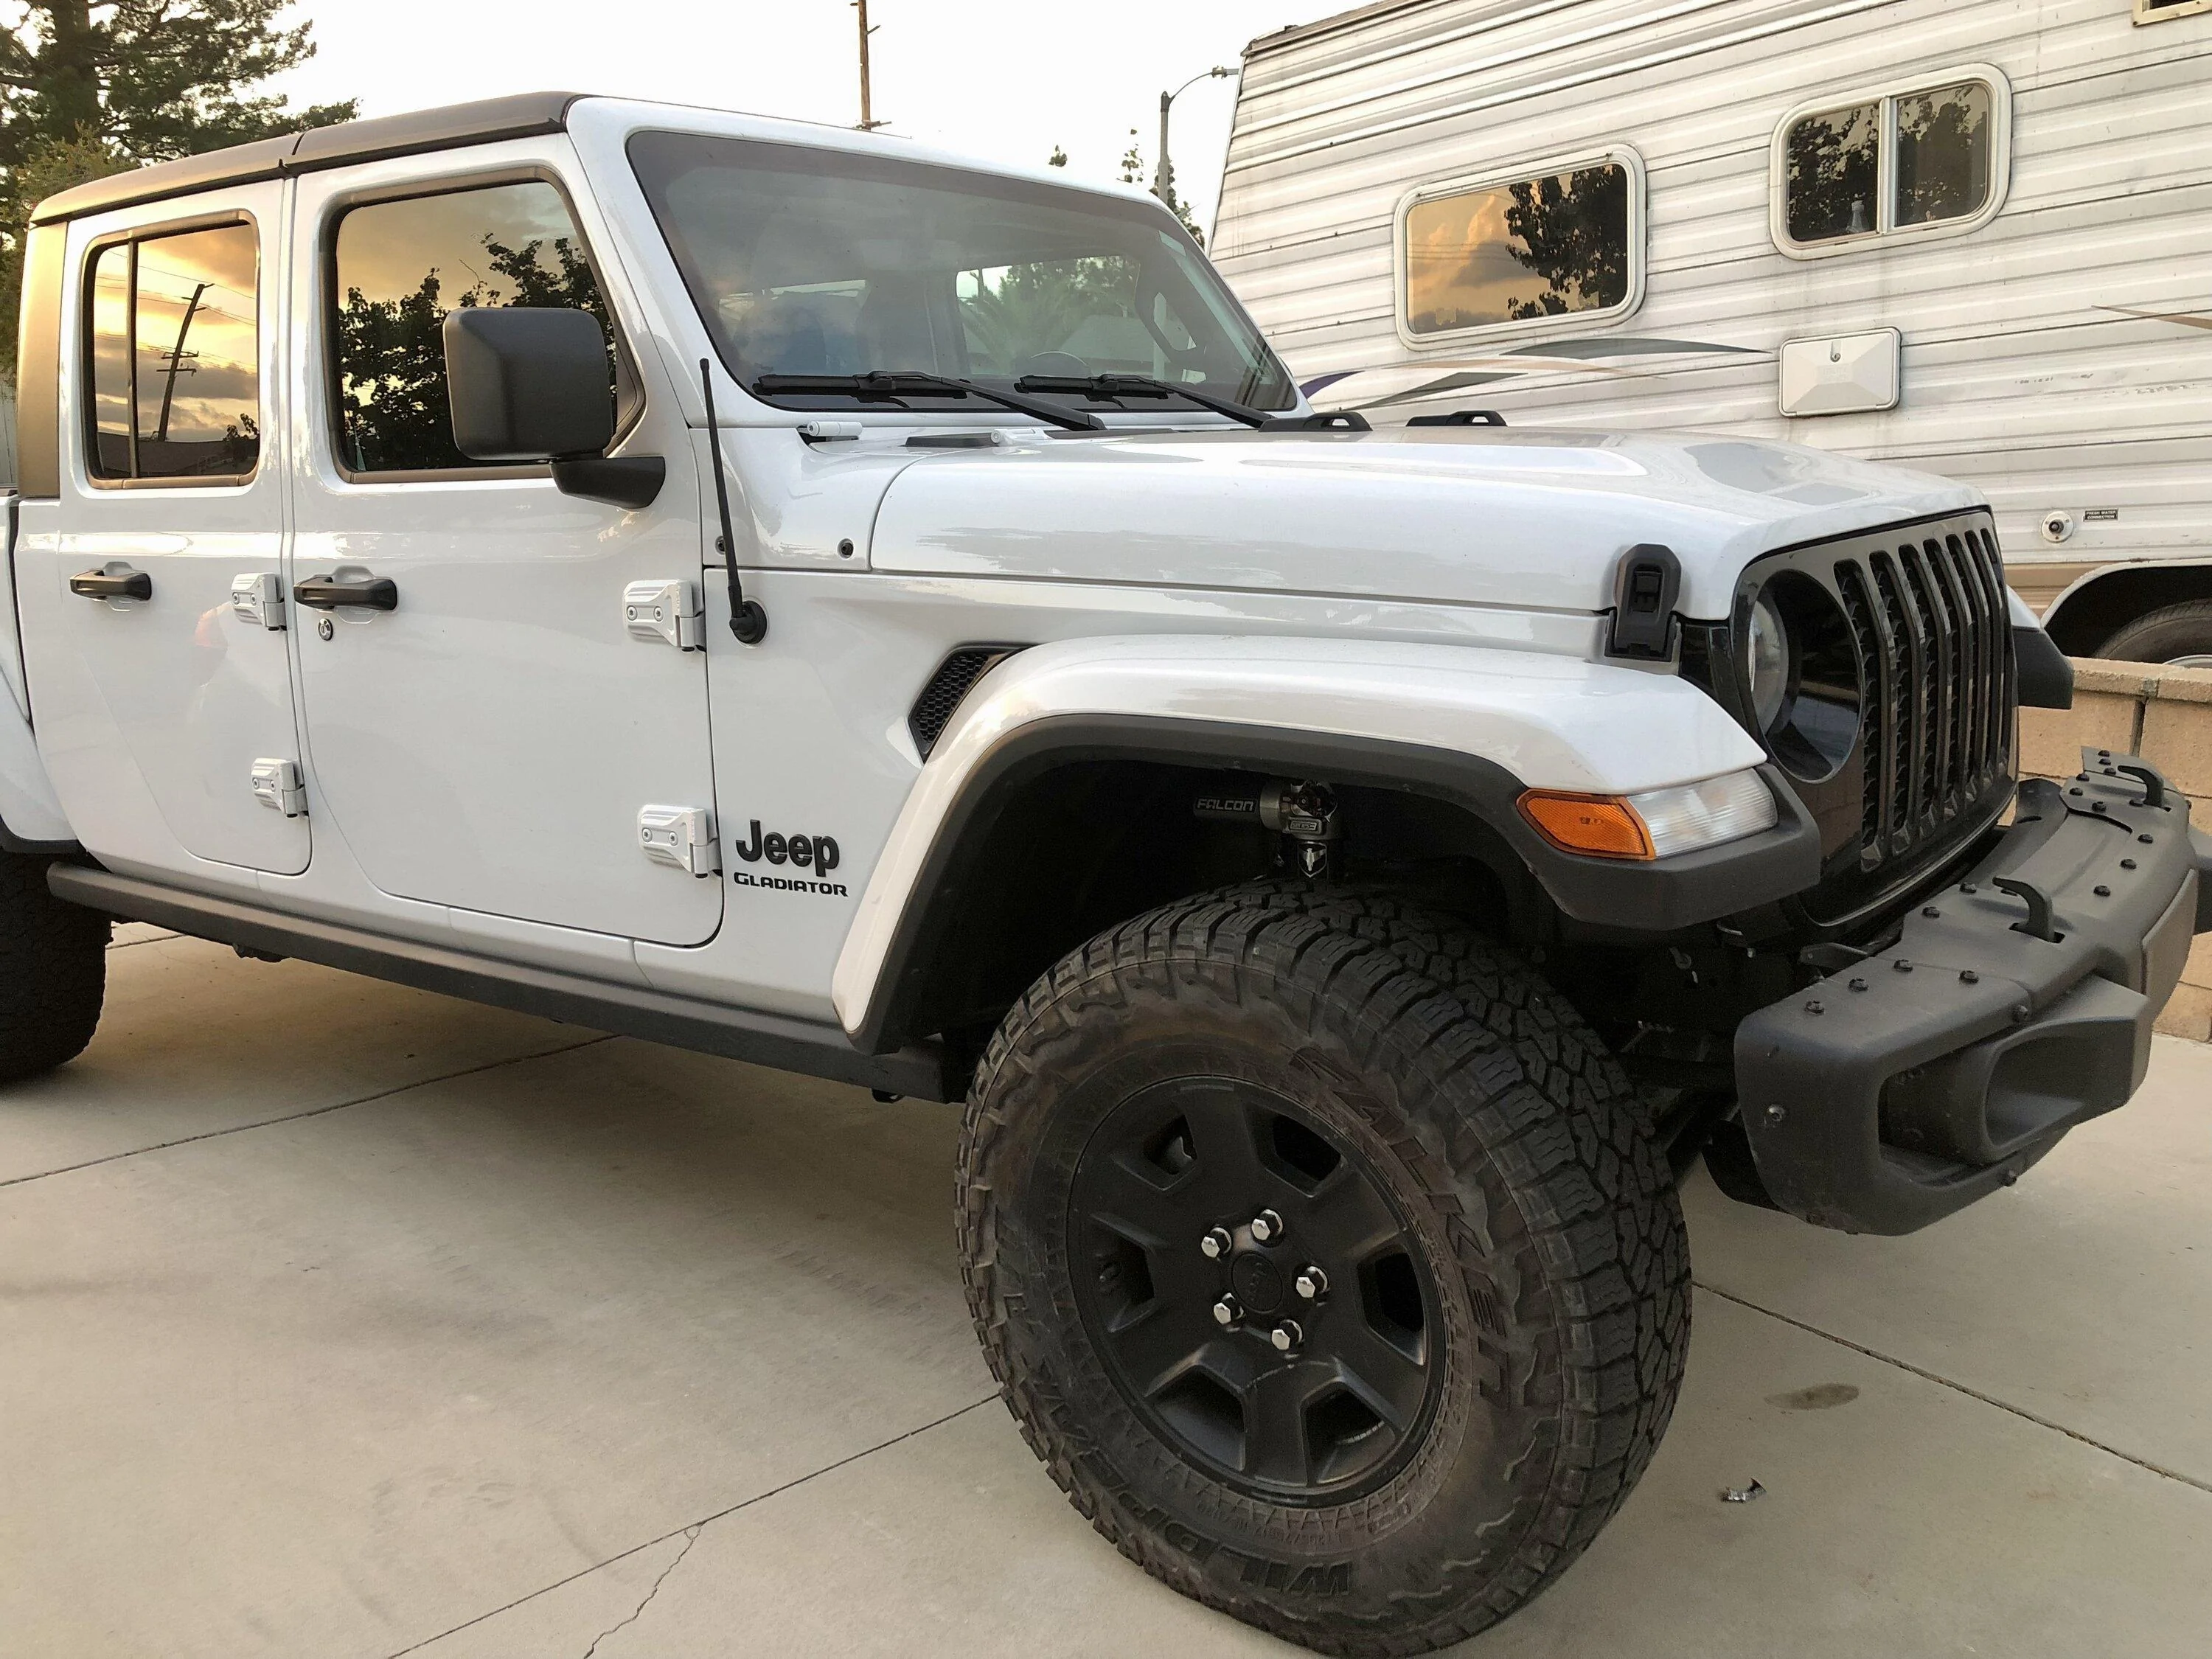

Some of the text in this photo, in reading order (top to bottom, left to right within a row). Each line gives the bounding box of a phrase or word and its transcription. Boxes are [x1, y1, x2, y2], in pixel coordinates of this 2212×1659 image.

[1197, 799, 1254, 811] FALCON
[735, 819, 840, 877] Jeep
[734, 872, 849, 897] GLADIATOR
